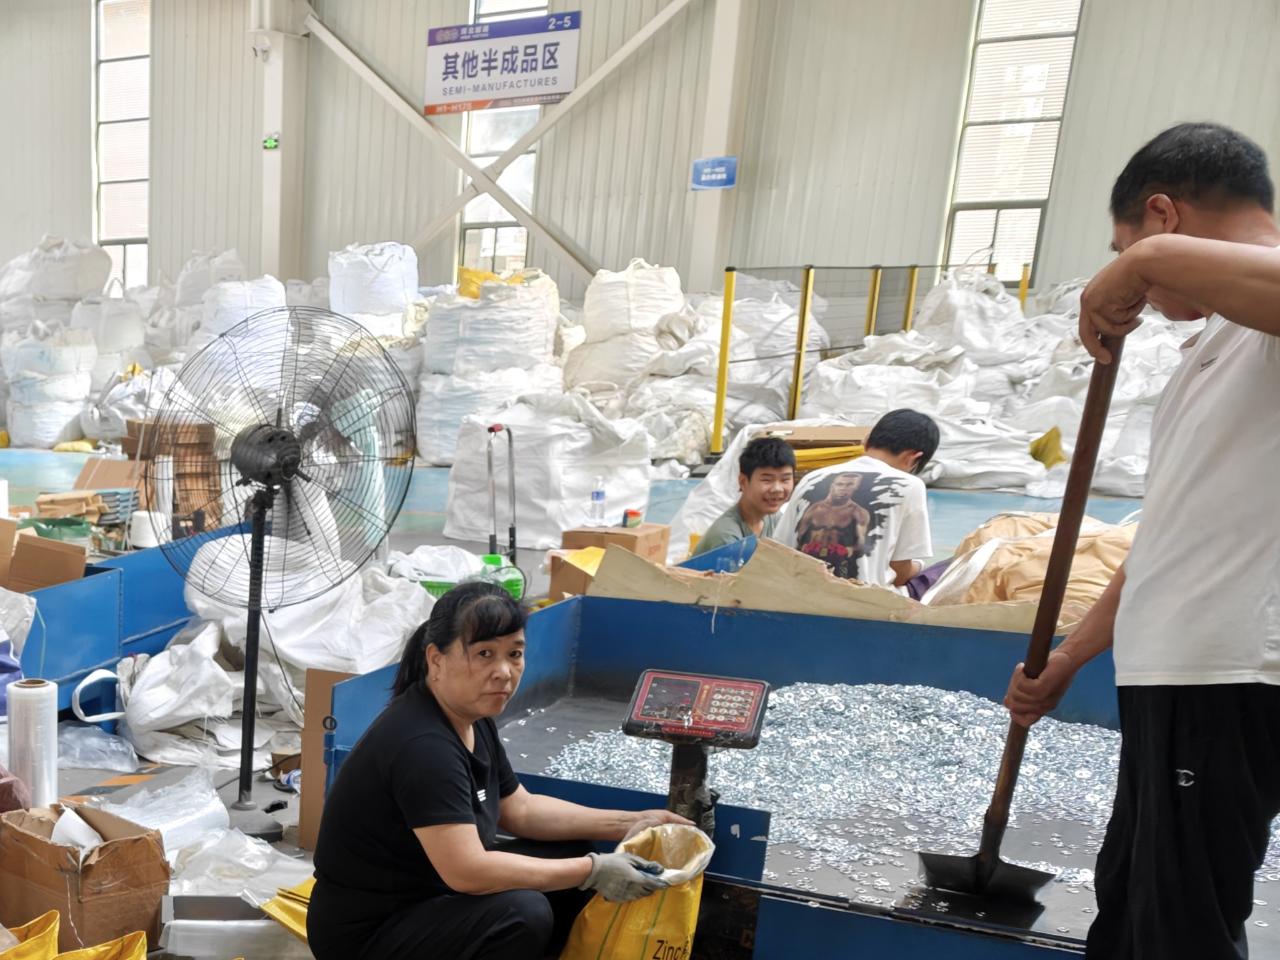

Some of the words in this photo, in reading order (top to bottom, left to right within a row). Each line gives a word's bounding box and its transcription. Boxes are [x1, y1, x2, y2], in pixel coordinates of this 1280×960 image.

[441, 42, 560, 82] 其他半成品区
[441, 76, 558, 96] SEMI-MANUFACTURES
